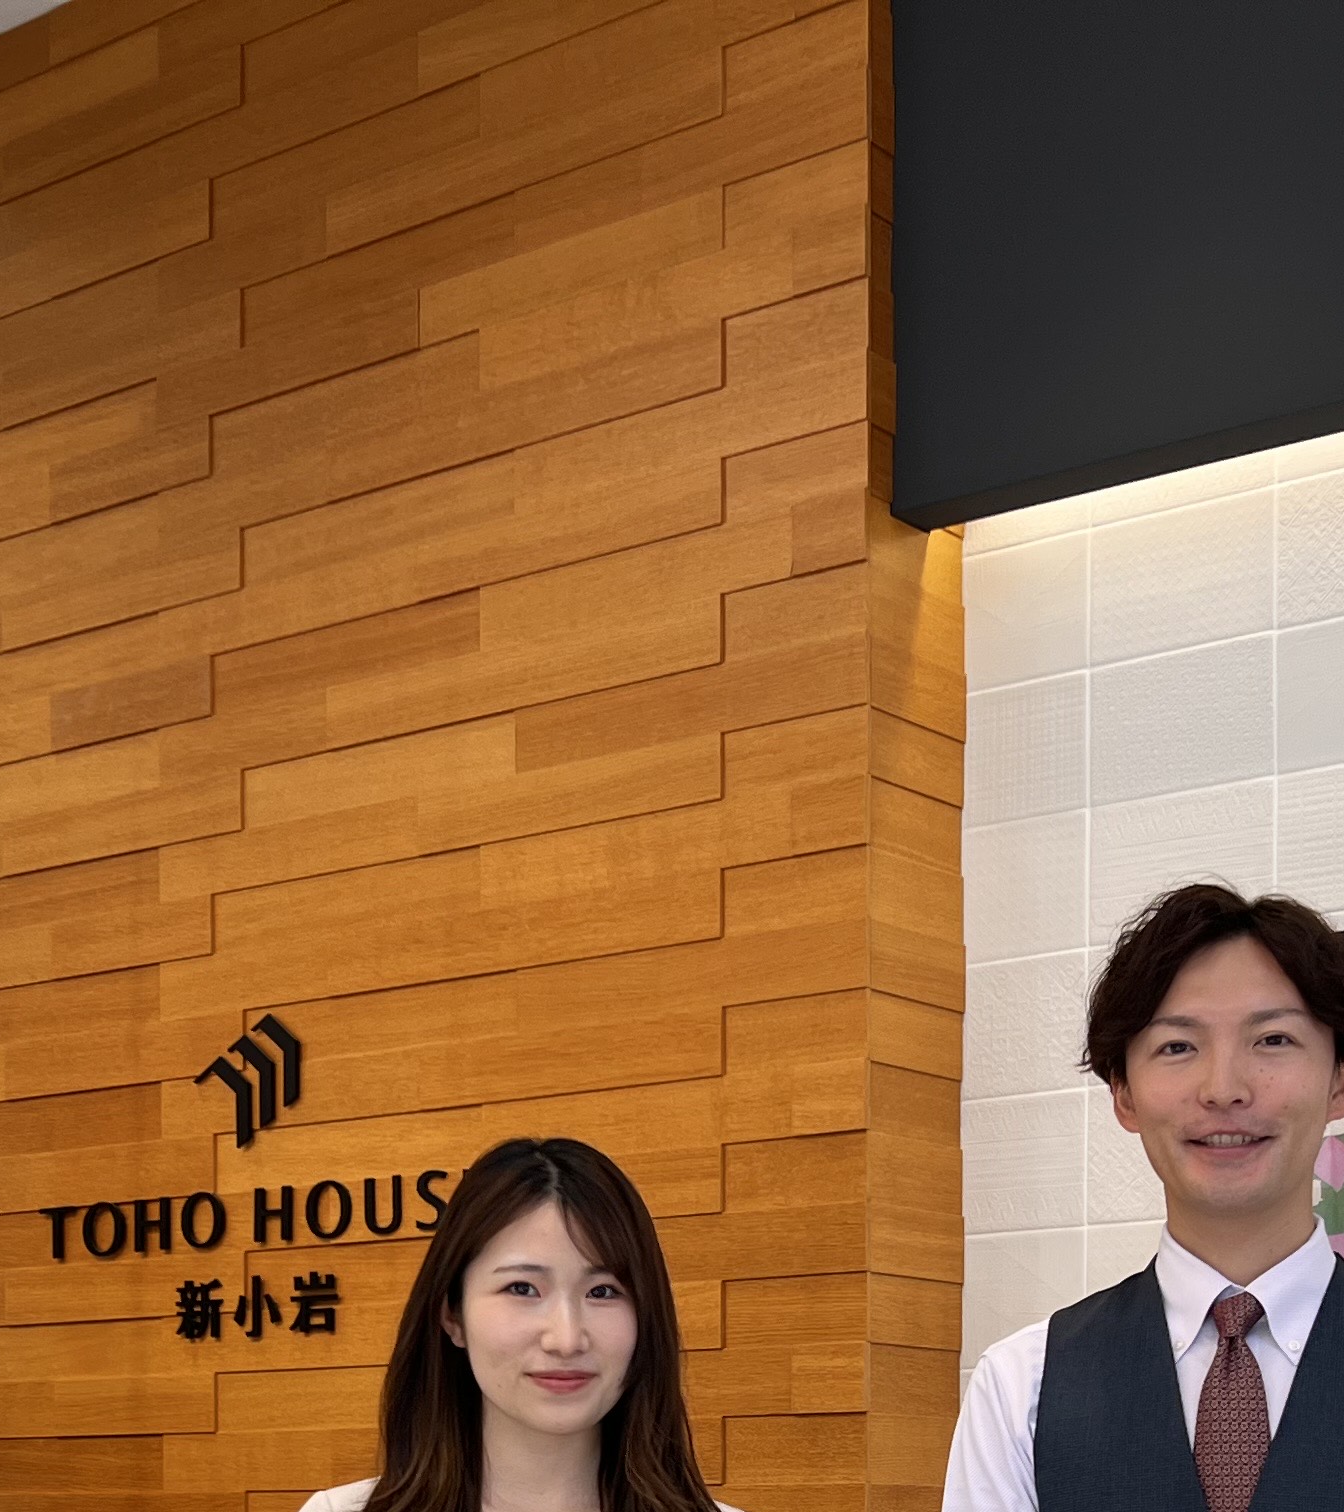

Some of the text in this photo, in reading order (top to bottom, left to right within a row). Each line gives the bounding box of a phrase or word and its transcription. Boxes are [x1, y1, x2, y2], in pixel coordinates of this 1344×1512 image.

[40, 1168, 471, 1261] TOHO HOUS
[175, 1271, 340, 1340] 新小岩
